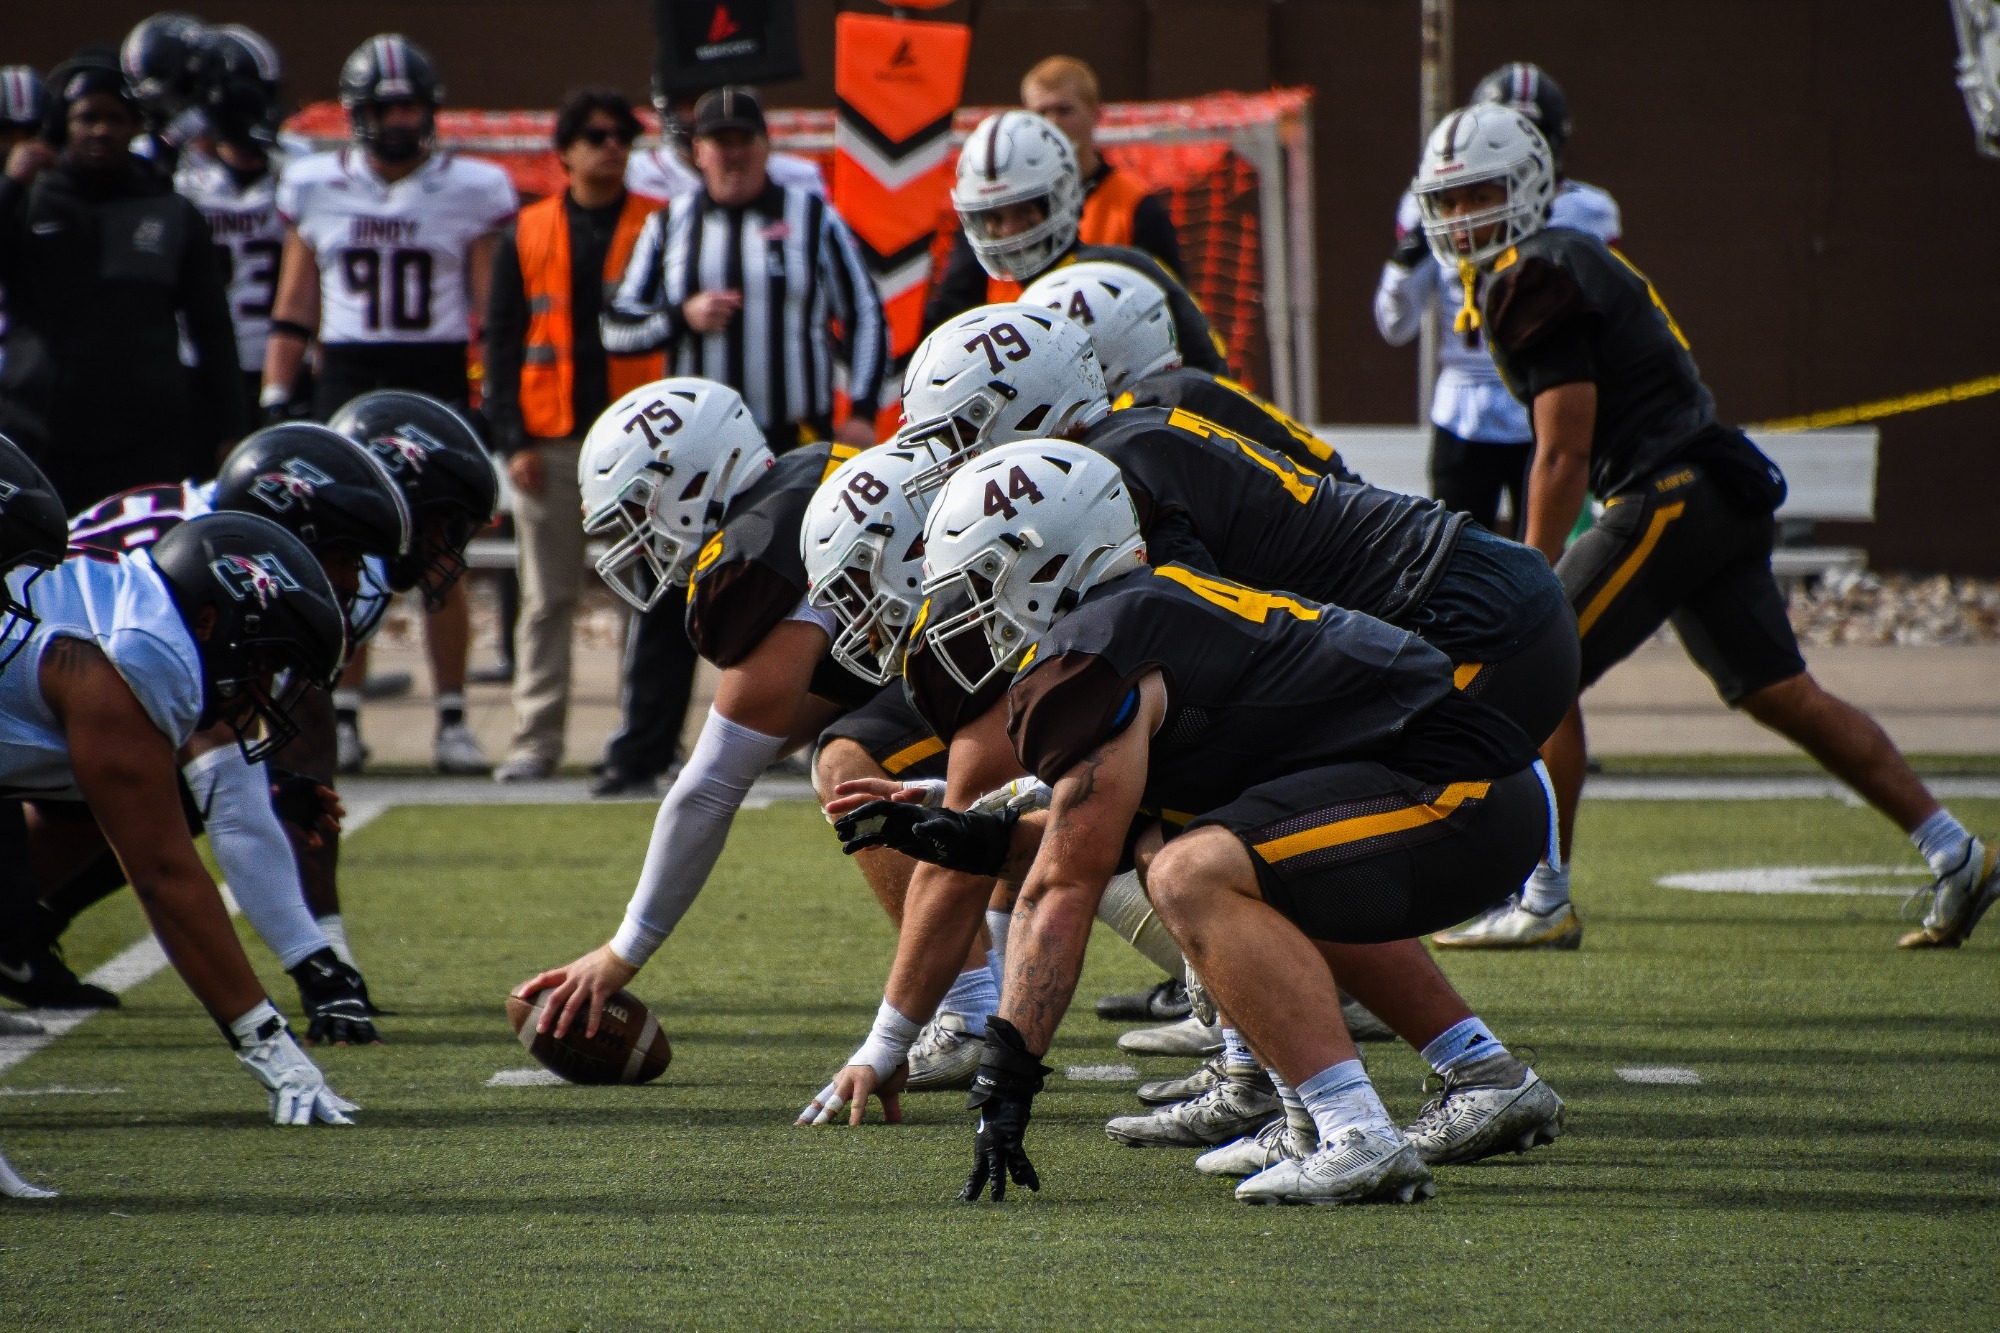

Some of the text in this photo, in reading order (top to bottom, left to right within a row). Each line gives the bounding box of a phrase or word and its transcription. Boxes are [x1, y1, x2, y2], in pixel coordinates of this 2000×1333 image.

[342, 247, 433, 331] 90
[963, 322, 1032, 375] 79
[622, 399, 684, 450] 75
[831, 470, 889, 526] 78
[983, 465, 1045, 522] 44
